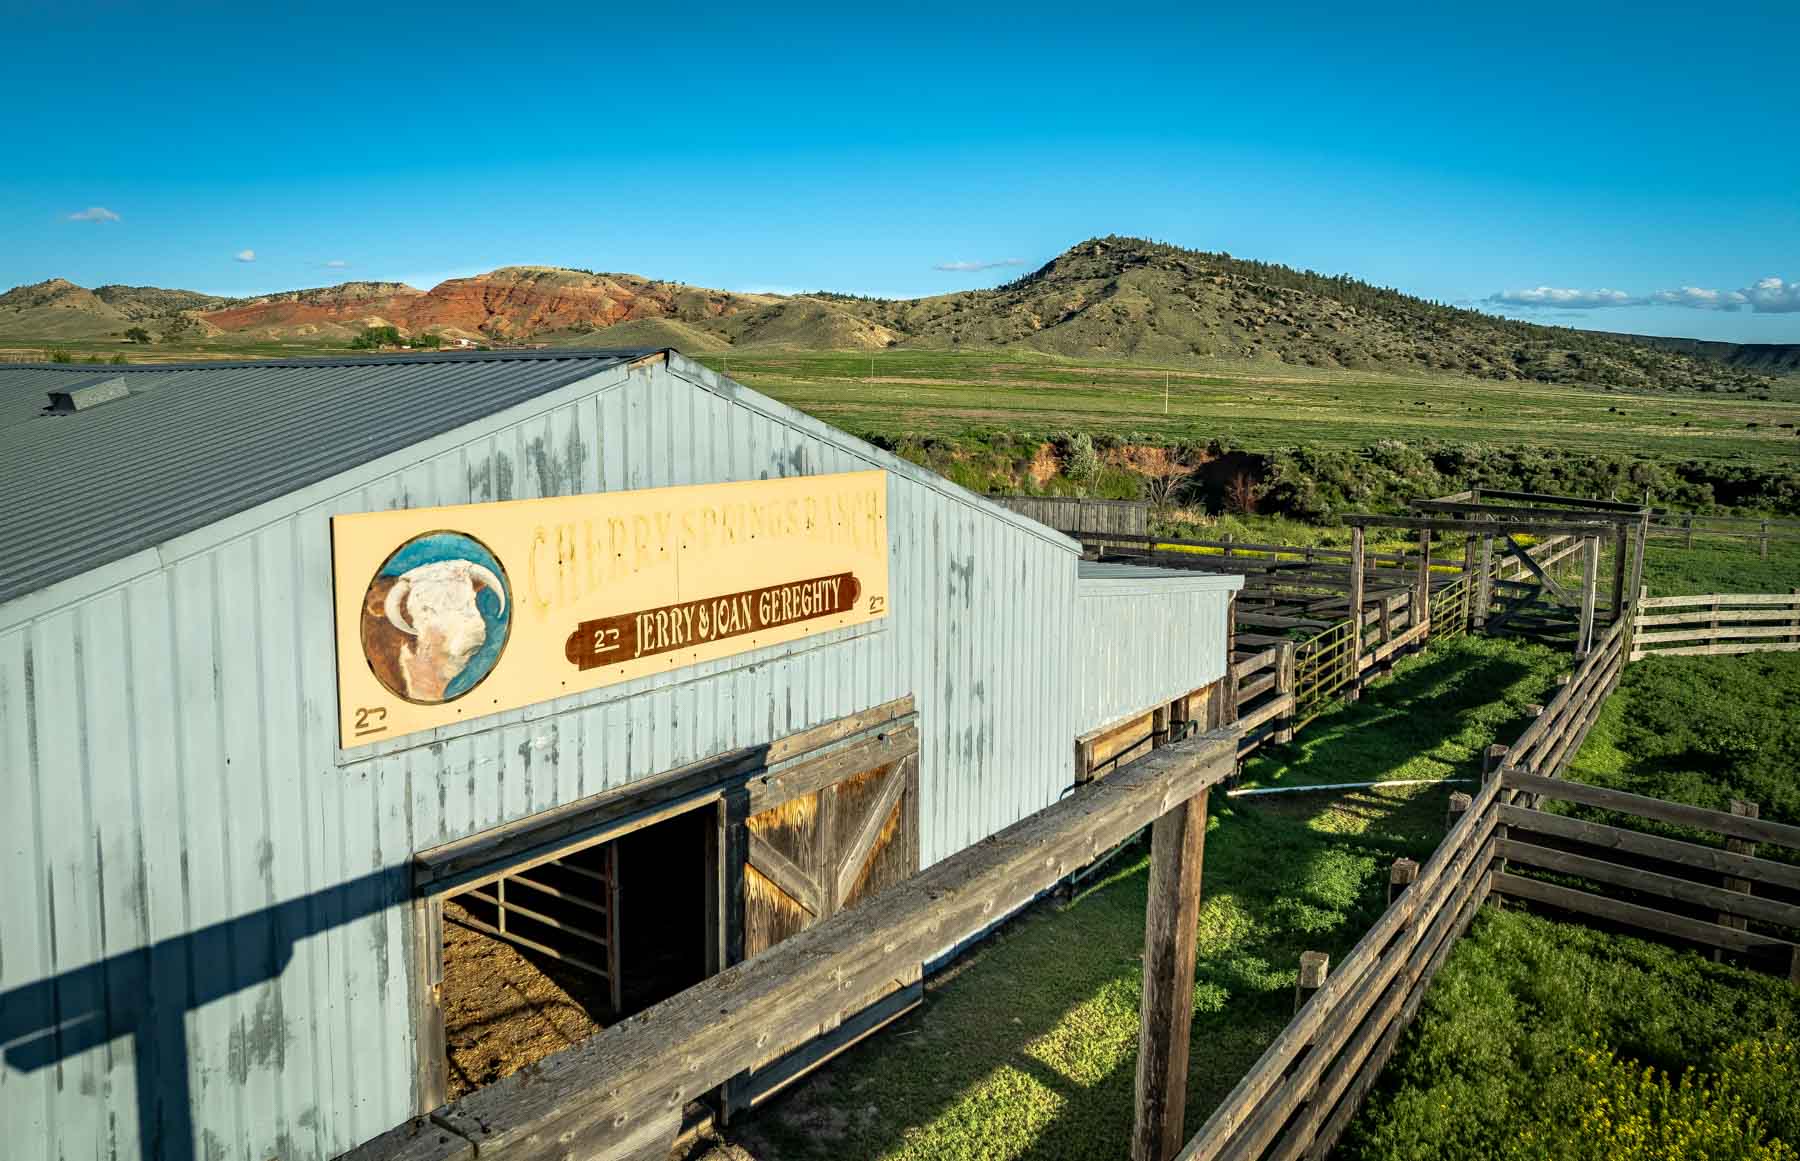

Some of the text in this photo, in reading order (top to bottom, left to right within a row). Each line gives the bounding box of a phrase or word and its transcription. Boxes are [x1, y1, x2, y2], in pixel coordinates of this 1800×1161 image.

[634, 577, 842, 657] JERRY & JOAN GEREGHTY
